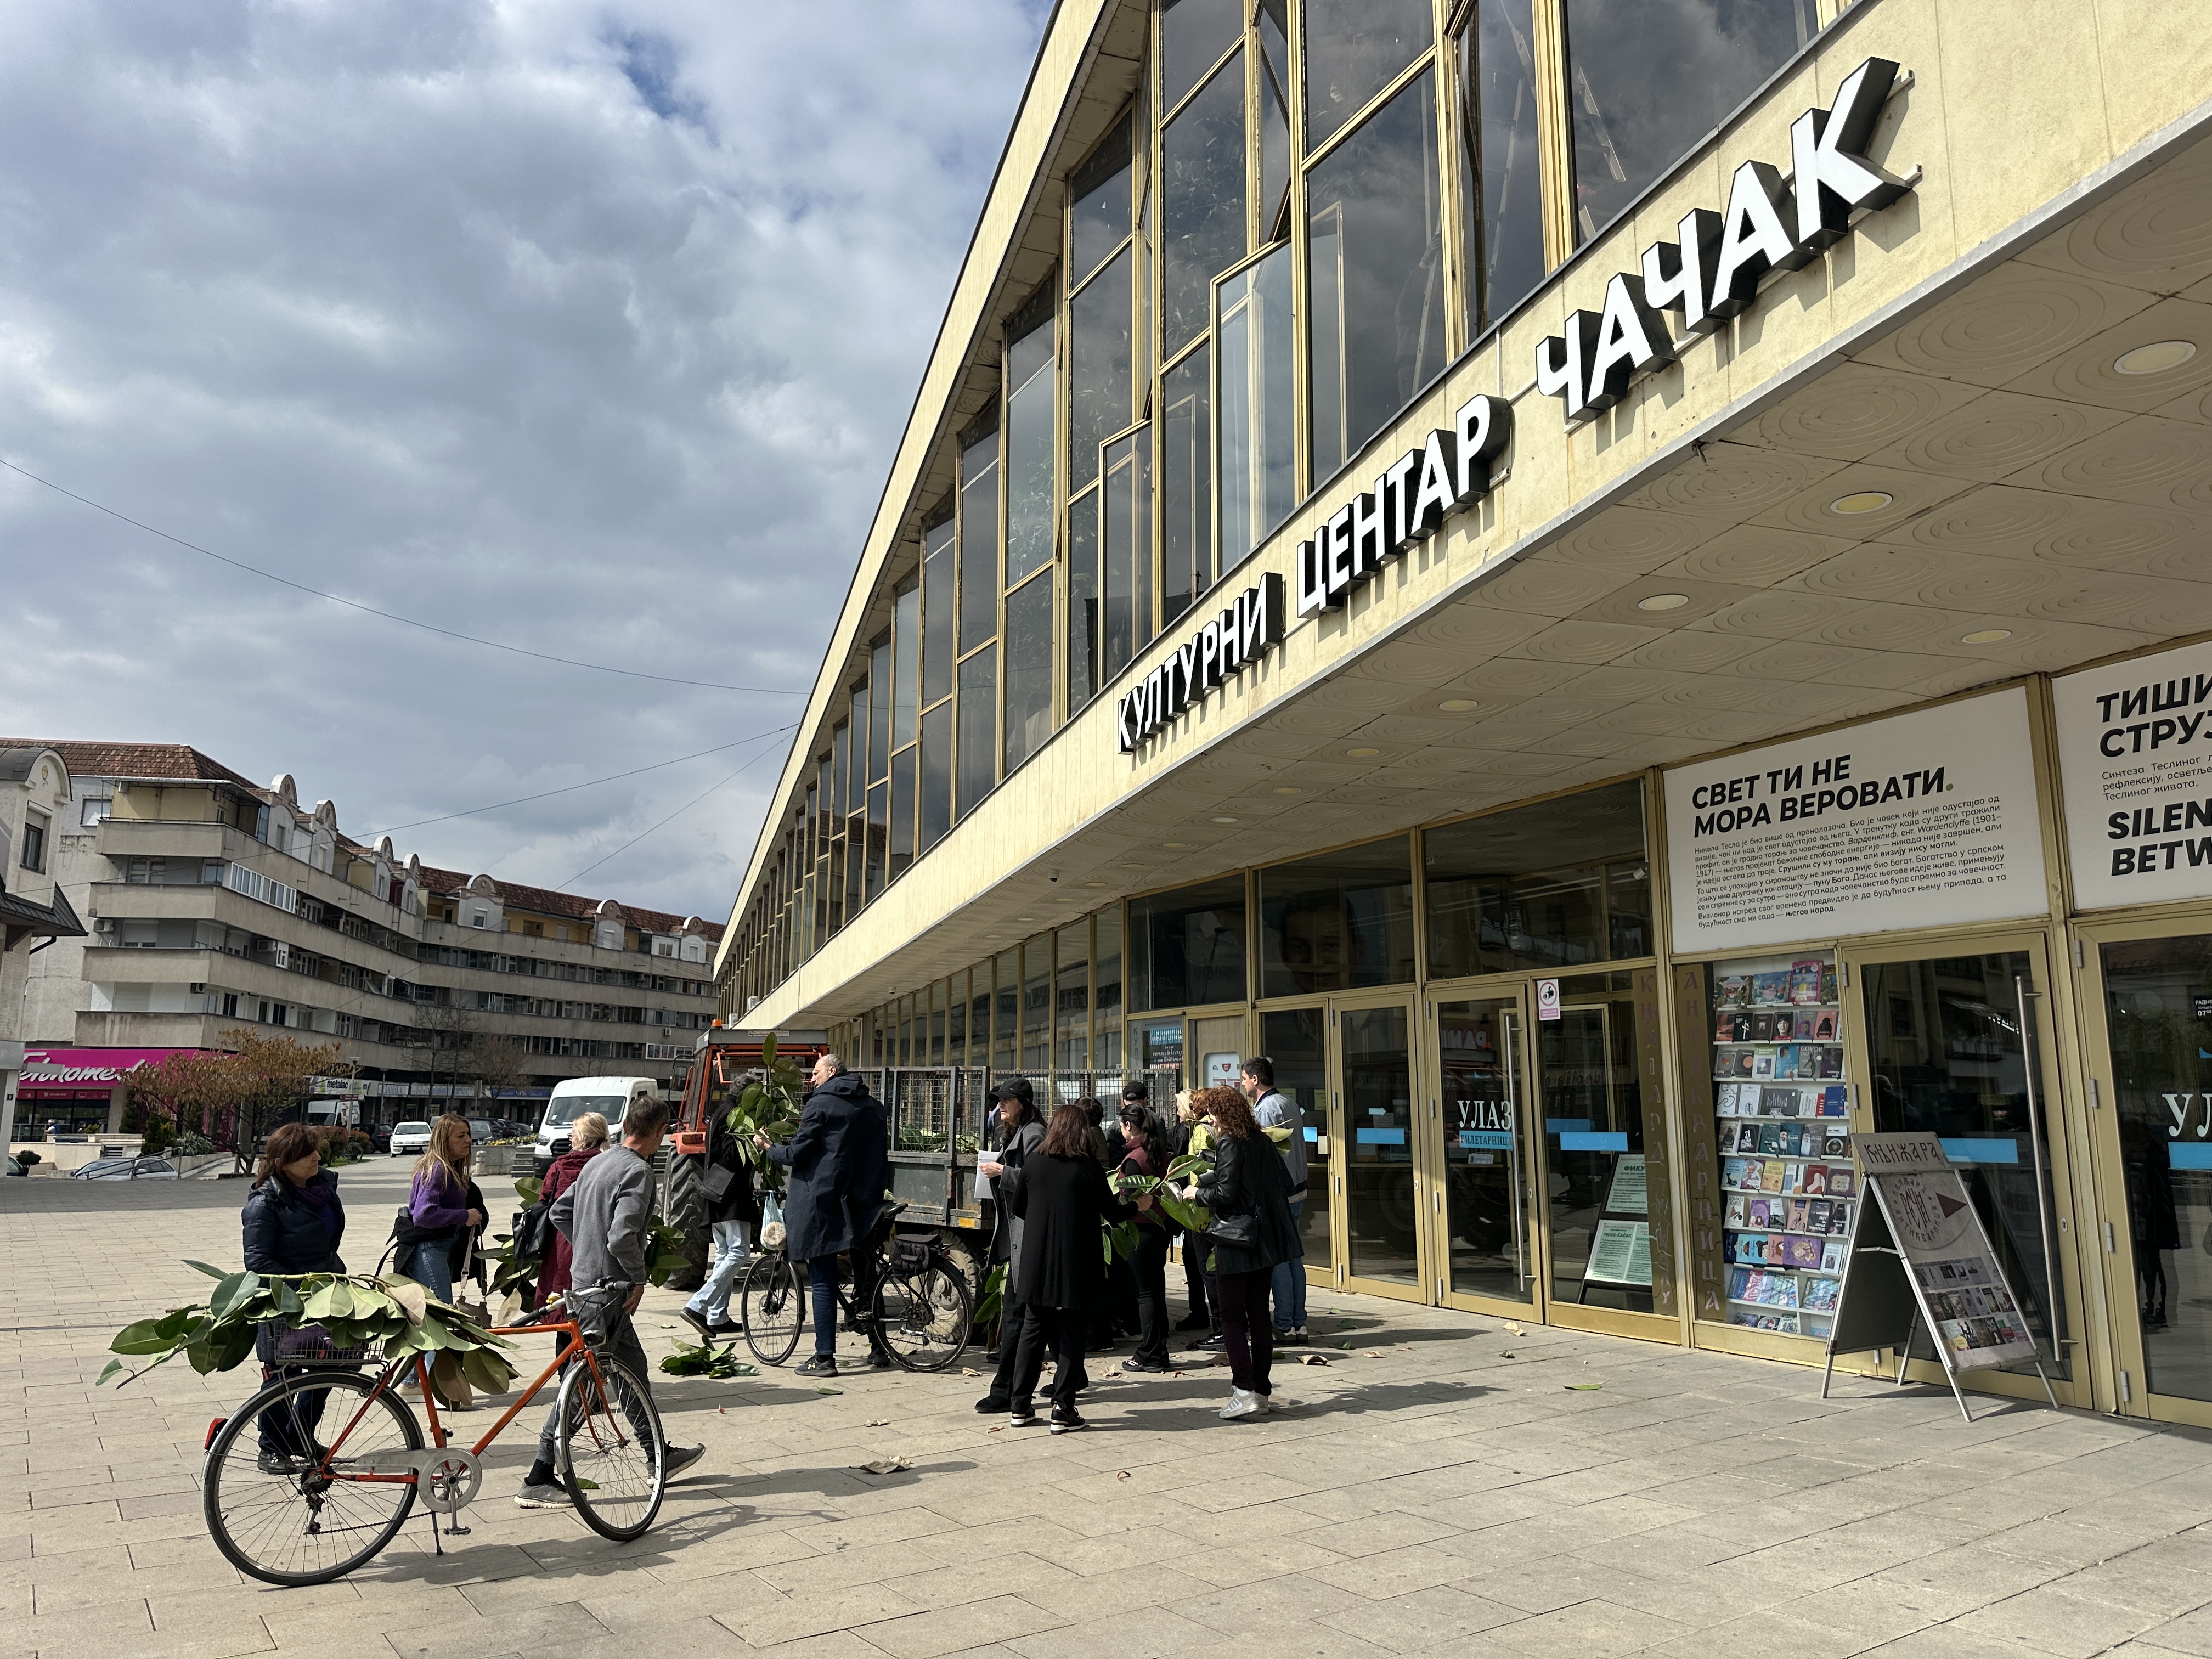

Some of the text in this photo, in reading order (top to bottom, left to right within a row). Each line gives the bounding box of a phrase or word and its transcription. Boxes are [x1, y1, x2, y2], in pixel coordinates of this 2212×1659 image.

[1118, 56, 1898, 754] КУЛТУРНИ ЦЕНТАР ЧАЧАК
[1691, 754, 1852, 810] СВЕТ ТИ НЕ
[2102, 756, 2201, 780] Синтеза Теслиног
[2103, 774, 2164, 791] рефлексију,
[2103, 780, 2198, 801] Теслиног живота.
[1694, 766, 1954, 839] МОРА ВЕРОВАТИ.
[1695, 843, 1718, 854] Никола
[1722, 840, 1740, 849] Тесла
[1741, 838, 1747, 847] је
[1750, 836, 1762, 844] био
[1785, 832, 1794, 840] од
[1850, 818, 1865, 827] Био
[1866, 816, 1874, 826] је
[1876, 814, 1900, 822] човек
[1902, 808, 1919, 820] који
[1922, 805, 1939, 816] није
[1942, 797, 1985, 813] одустајао
[1988, 796, 1999, 805] од
[2107, 798, 2212, 839] SILEN
[1695, 852, 1717, 864] визије,
[1742, 847, 1755, 855] кад
[1756, 844, 1763, 853] је
[1782, 835, 1817, 849] одустајао
[1819, 834, 1829, 843] од
[1831, 831, 1852, 839] њега.
[1860, 823, 1897, 836] тренутку
[1899, 819, 1919, 829] када
[1922, 817, 1931, 825] су
[1933, 812, 1958, 823] други
[1960, 805, 2000, 819] тражили
[1695, 859, 1720, 871] профит,
[1731, 856, 1737, 865] је
[1739, 854, 1762, 864] градио
[1764, 849, 1787, 860] торањ
[1799, 840, 1846, 853] човечанство.
[1917, 817, 1970, 835] Wardenclyffe
[1723, 865, 1744, 873] његов
[1745, 858, 1775, 871] пројекат
[1776, 853, 1808, 865] бежичне
[1809, 847, 1844, 861] слободне
[1846, 842, 1880, 855] енергије
[1892, 837, 1921, 848] никада
[1923, 832, 1940, 843] није
[1943, 827, 1983, 840] завршен,
[2111, 836, 2212, 876] BETW
[1696, 878, 1701, 887] је
[1703, 875, 1720, 885] идеја
[1722, 873, 1745, 881] остала
[1756, 866, 1776, 877] траје.
[1778, 861, 1811, 874] Срушили
[1822, 859, 1832, 867] му
[1833, 855, 1861, 866] торањ,
[1880, 846, 1907, 859] визију
[1908, 845, 1928, 855] нису
[1929, 840, 1957, 850] могли.
[1697, 893, 1717, 904] језику
[1731, 887, 1764, 899] другачију
[1765, 881, 1803, 894] конотацију
[1813, 879, 1830, 888] пуну
[1832, 874, 1852, 883] Бога.
[1852, 870, 1878, 882] Данас
[1879, 868, 1908, 877] његове
[1909, 862, 1931, 874] идеје
[1932, 861, 1956, 871] живе,
[1957, 852, 2004, 868] примењују
[1710, 900, 1738, 910] спремне
[1756, 895, 1775, 904] сутра
[1799, 889, 1819, 898] сутра
[1820, 886, 1839, 895] када
[1839, 879, 1889, 891] човечанство
[1890, 874, 1909, 885] буде
[1910, 871, 1945, 883] спремно
[1958, 863, 2005, 875] човечност.
[1728, 879, 1758, 891] упокојио
[1765, 873, 1808, 886] сиромаштву
[1820, 868, 1842, 876] значи
[1844, 866, 1853, 874] да
[1855, 862, 1871, 873] није
[1874, 860, 1888, 868] био
[1890, 856, 1914, 866] богат.
[1916, 849, 1957, 862] Богатство
[1967, 844, 2004, 856] српском
[1698, 909, 1730, 921] Визионар
[1732, 907, 1756, 917] испред
[1776, 901, 1806, 911] времена
[1809, 895, 1849, 907] предвидео
[1851, 892, 1858, 901] је
[1861, 892, 1870, 900] да
[1874, 884, 1915, 899] будућност
[1918, 883, 1941, 893] њему
[1944, 877, 1984, 889] припада,
[1699, 917, 1732, 929] будућност
[1758, 913, 1774, 922] сада
[1810, 906, 1835, 916] народ.
[326, 1077, 348, 1090] metalac
[1457, 1100, 1512, 1130] УЛАЗ
